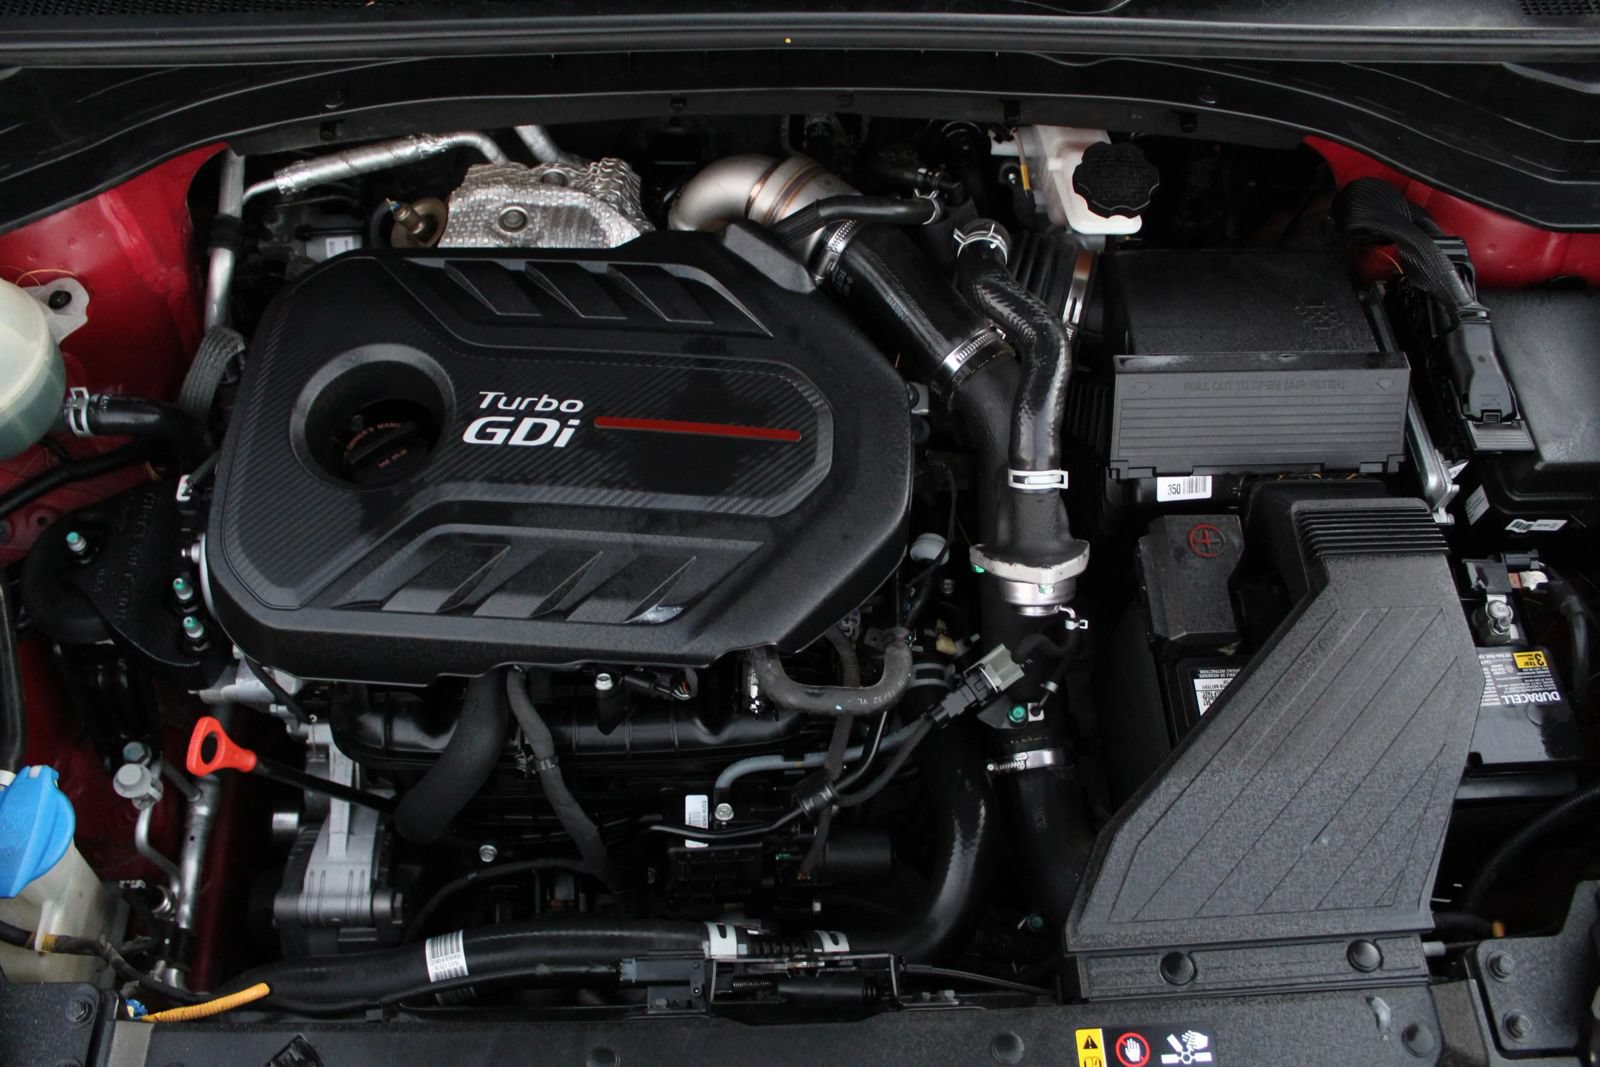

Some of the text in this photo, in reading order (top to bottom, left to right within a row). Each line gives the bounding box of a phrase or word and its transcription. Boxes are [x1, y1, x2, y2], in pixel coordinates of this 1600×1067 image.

[479, 391, 584, 413] Turbo
[463, 416, 581, 448] GDi
[1167, 483, 1181, 496] 350
[1535, 653, 1545, 667] 3
[1501, 692, 1561, 705] DURACELL
